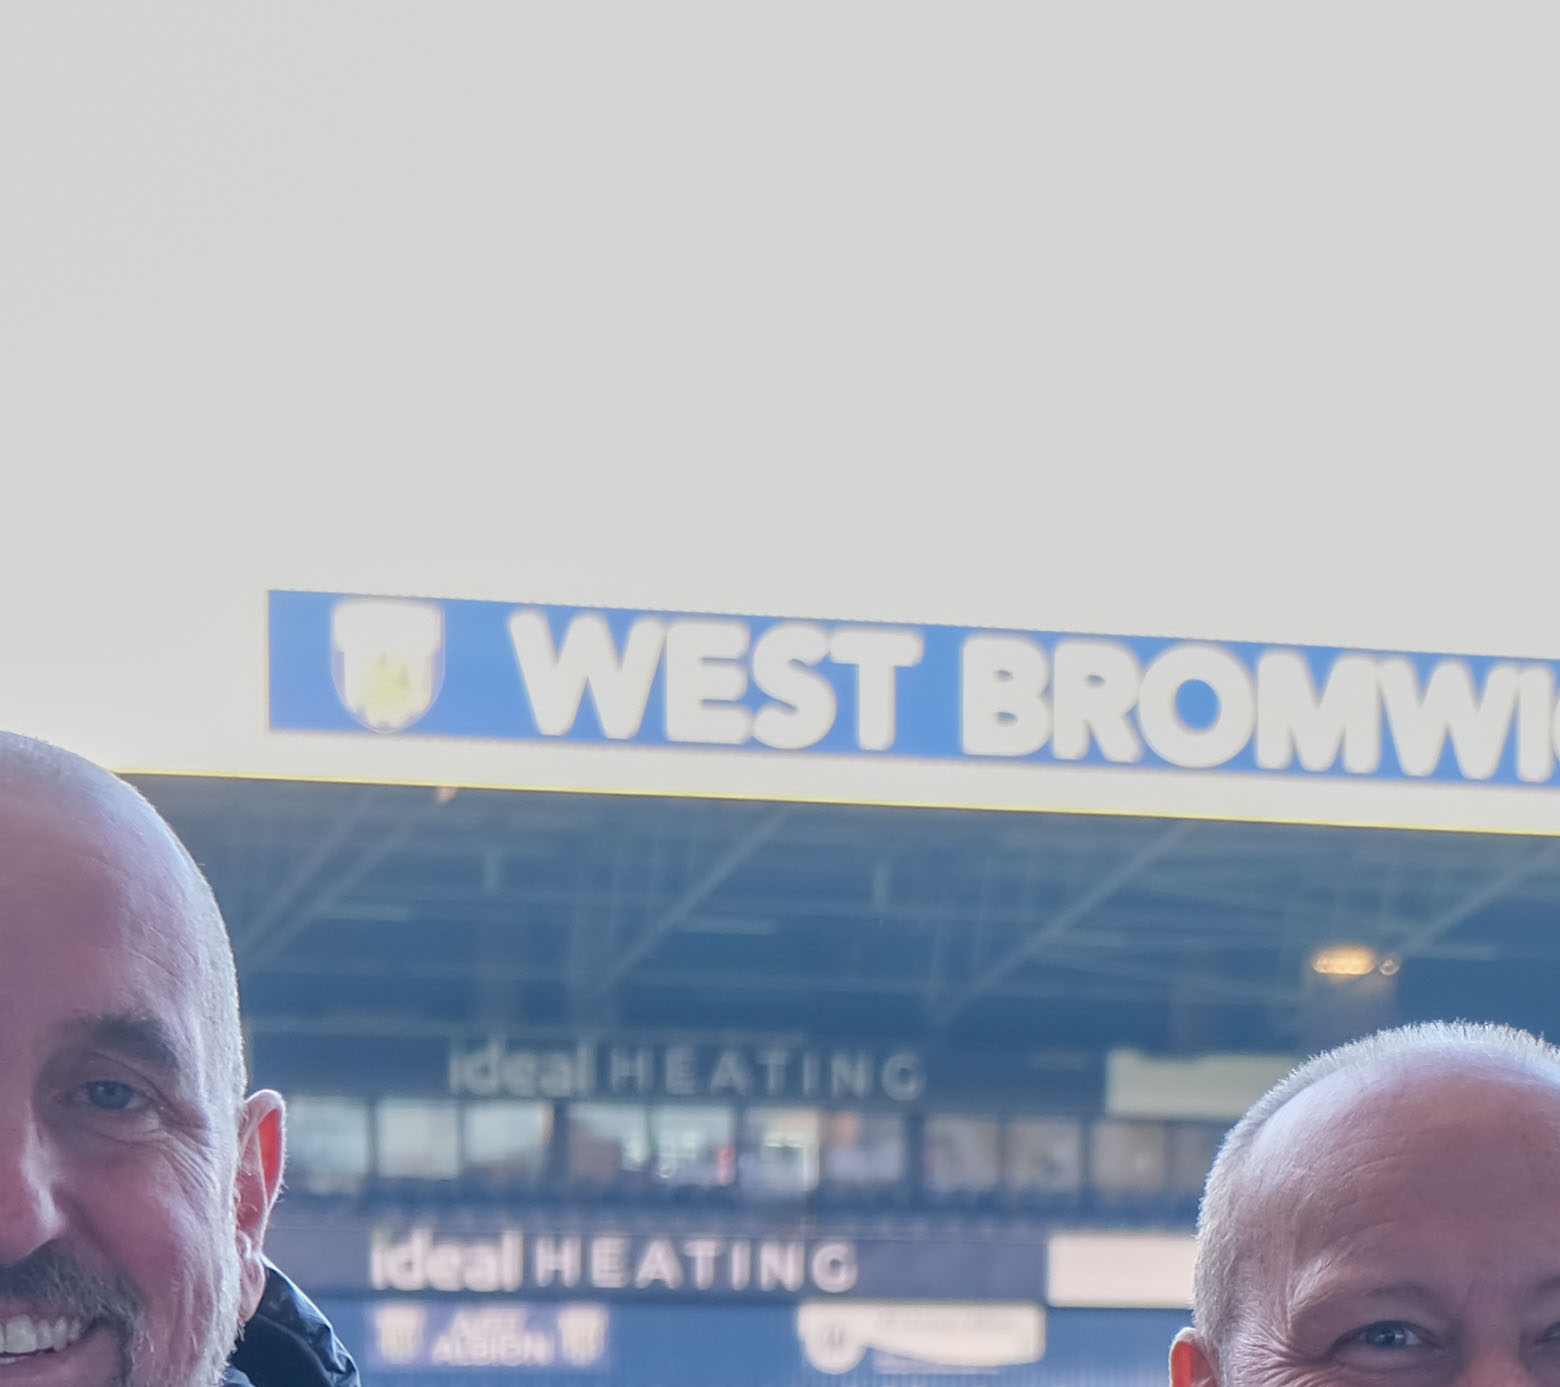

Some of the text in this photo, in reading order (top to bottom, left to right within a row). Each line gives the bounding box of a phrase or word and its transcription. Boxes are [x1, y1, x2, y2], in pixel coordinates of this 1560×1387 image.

[509, 611, 924, 750] WEST
[448, 1038, 925, 1101] ideal HEATING
[370, 1228, 859, 1293] ideal HEATING
